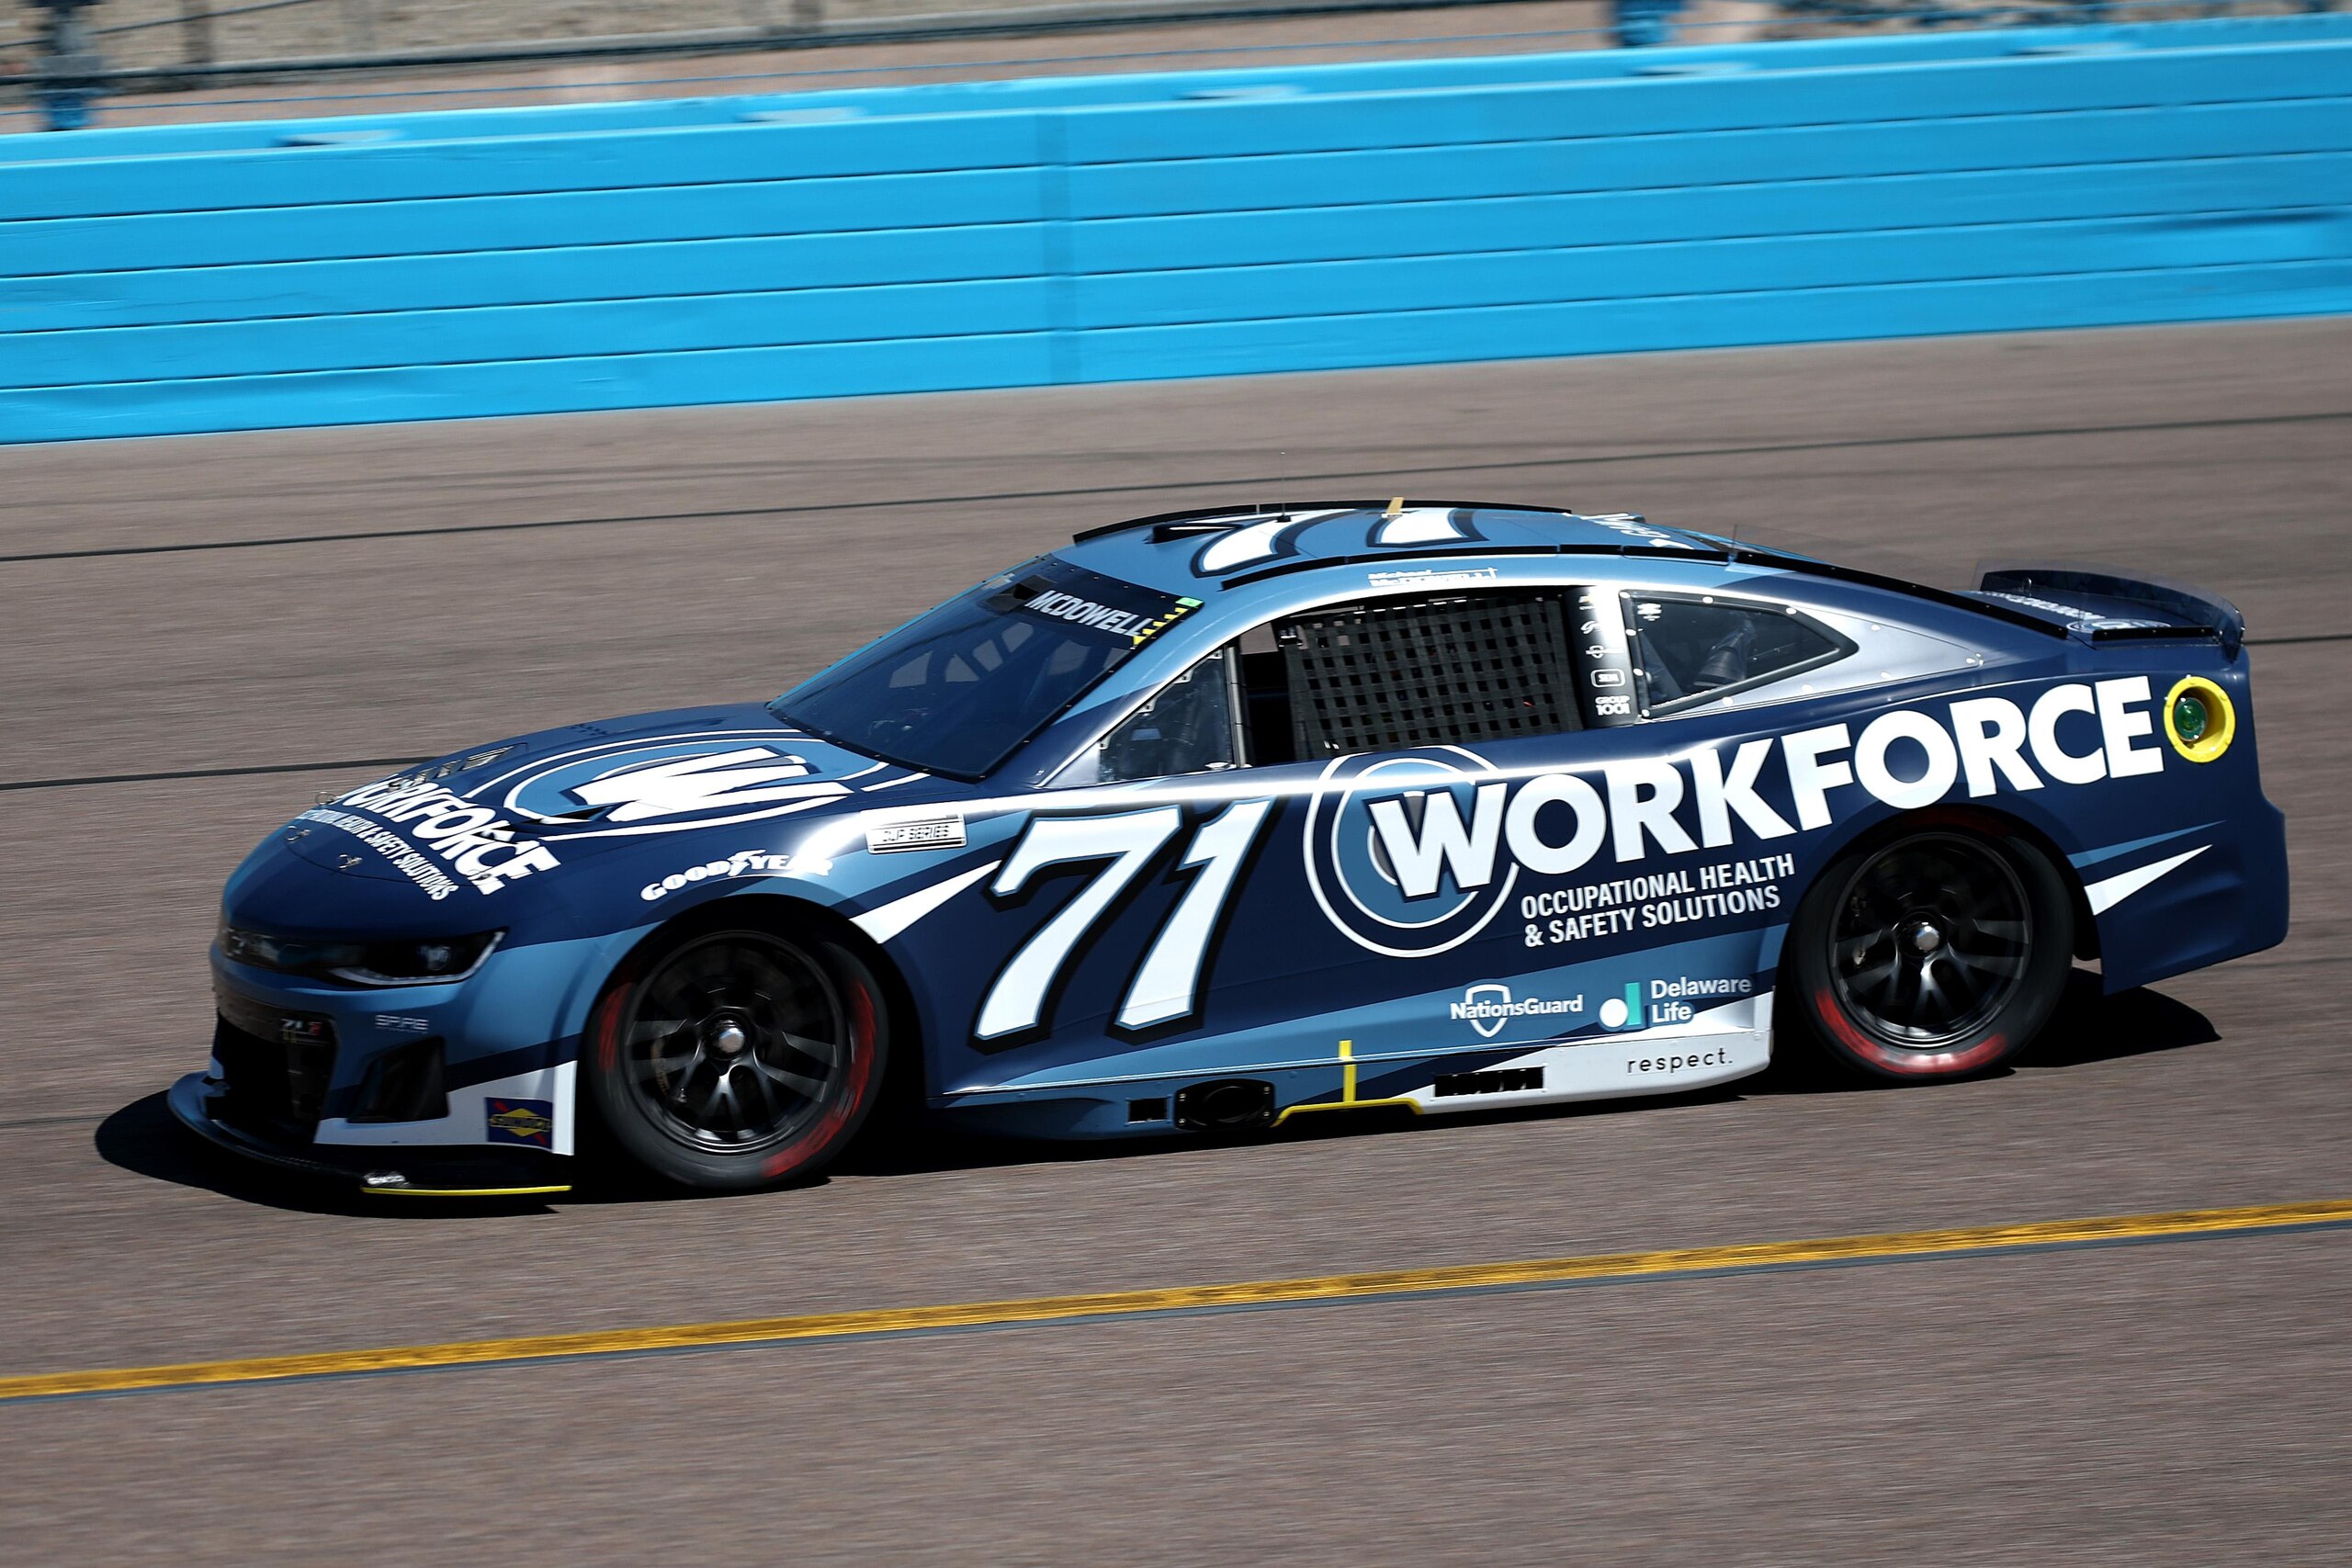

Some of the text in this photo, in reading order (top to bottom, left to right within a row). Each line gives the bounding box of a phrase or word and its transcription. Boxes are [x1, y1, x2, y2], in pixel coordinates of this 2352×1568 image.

[1024, 590, 1154, 637] MCDOWELL
[1595, 703, 1631, 716] 1001
[1369, 676, 2164, 897] WORKFORCE
[334, 774, 561, 896] ORKFORCE
[1521, 853, 1795, 919] OCCUPATIONAL HEALTH
[974, 795, 1278, 1042] 71
[1524, 885, 1781, 948] & SAFETY SOLUTIONS
[1450, 994, 1584, 1021] NationsGuard
[1650, 976, 1753, 999] Delaware
[1652, 1000, 1692, 1024] Life
[1627, 1047, 1734, 1075] respect.
